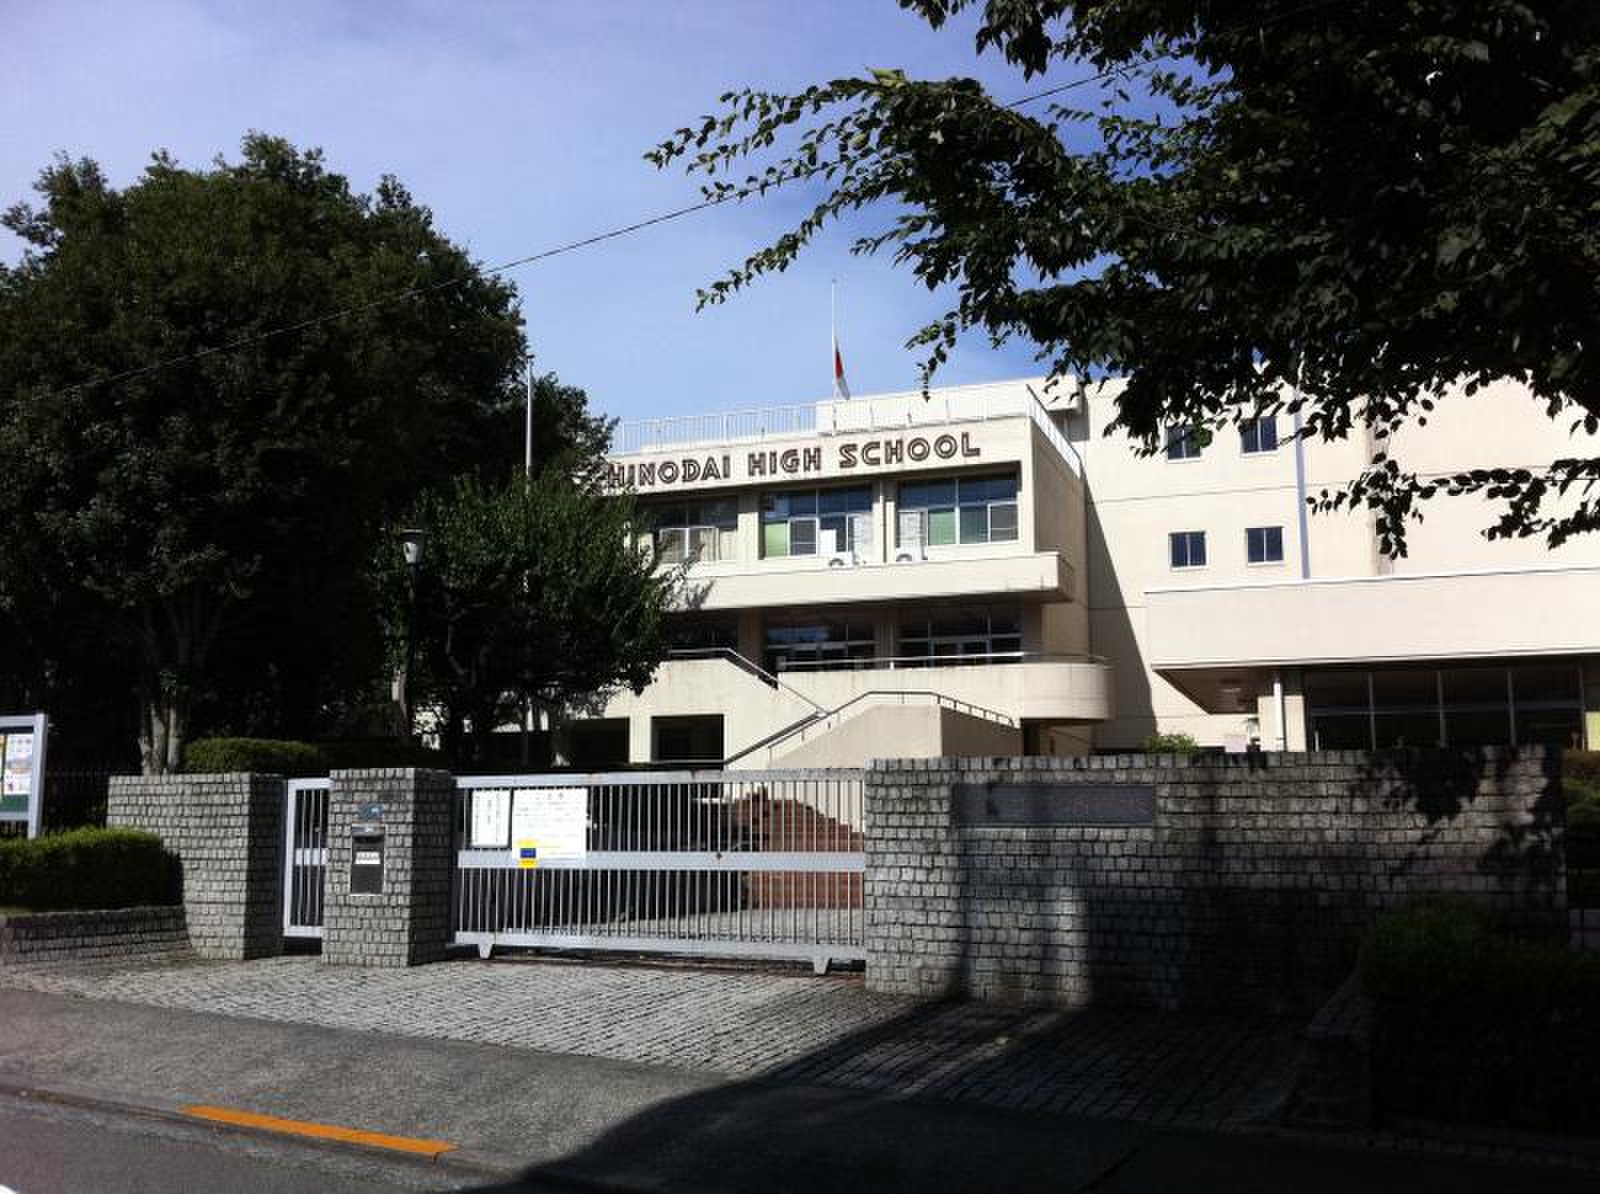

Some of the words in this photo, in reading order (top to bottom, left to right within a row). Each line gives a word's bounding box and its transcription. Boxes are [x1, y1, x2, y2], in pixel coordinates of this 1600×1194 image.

[607, 455, 730, 486] HINODAI
[748, 446, 822, 477] HIGH
[839, 432, 981, 469] SCHOOL
